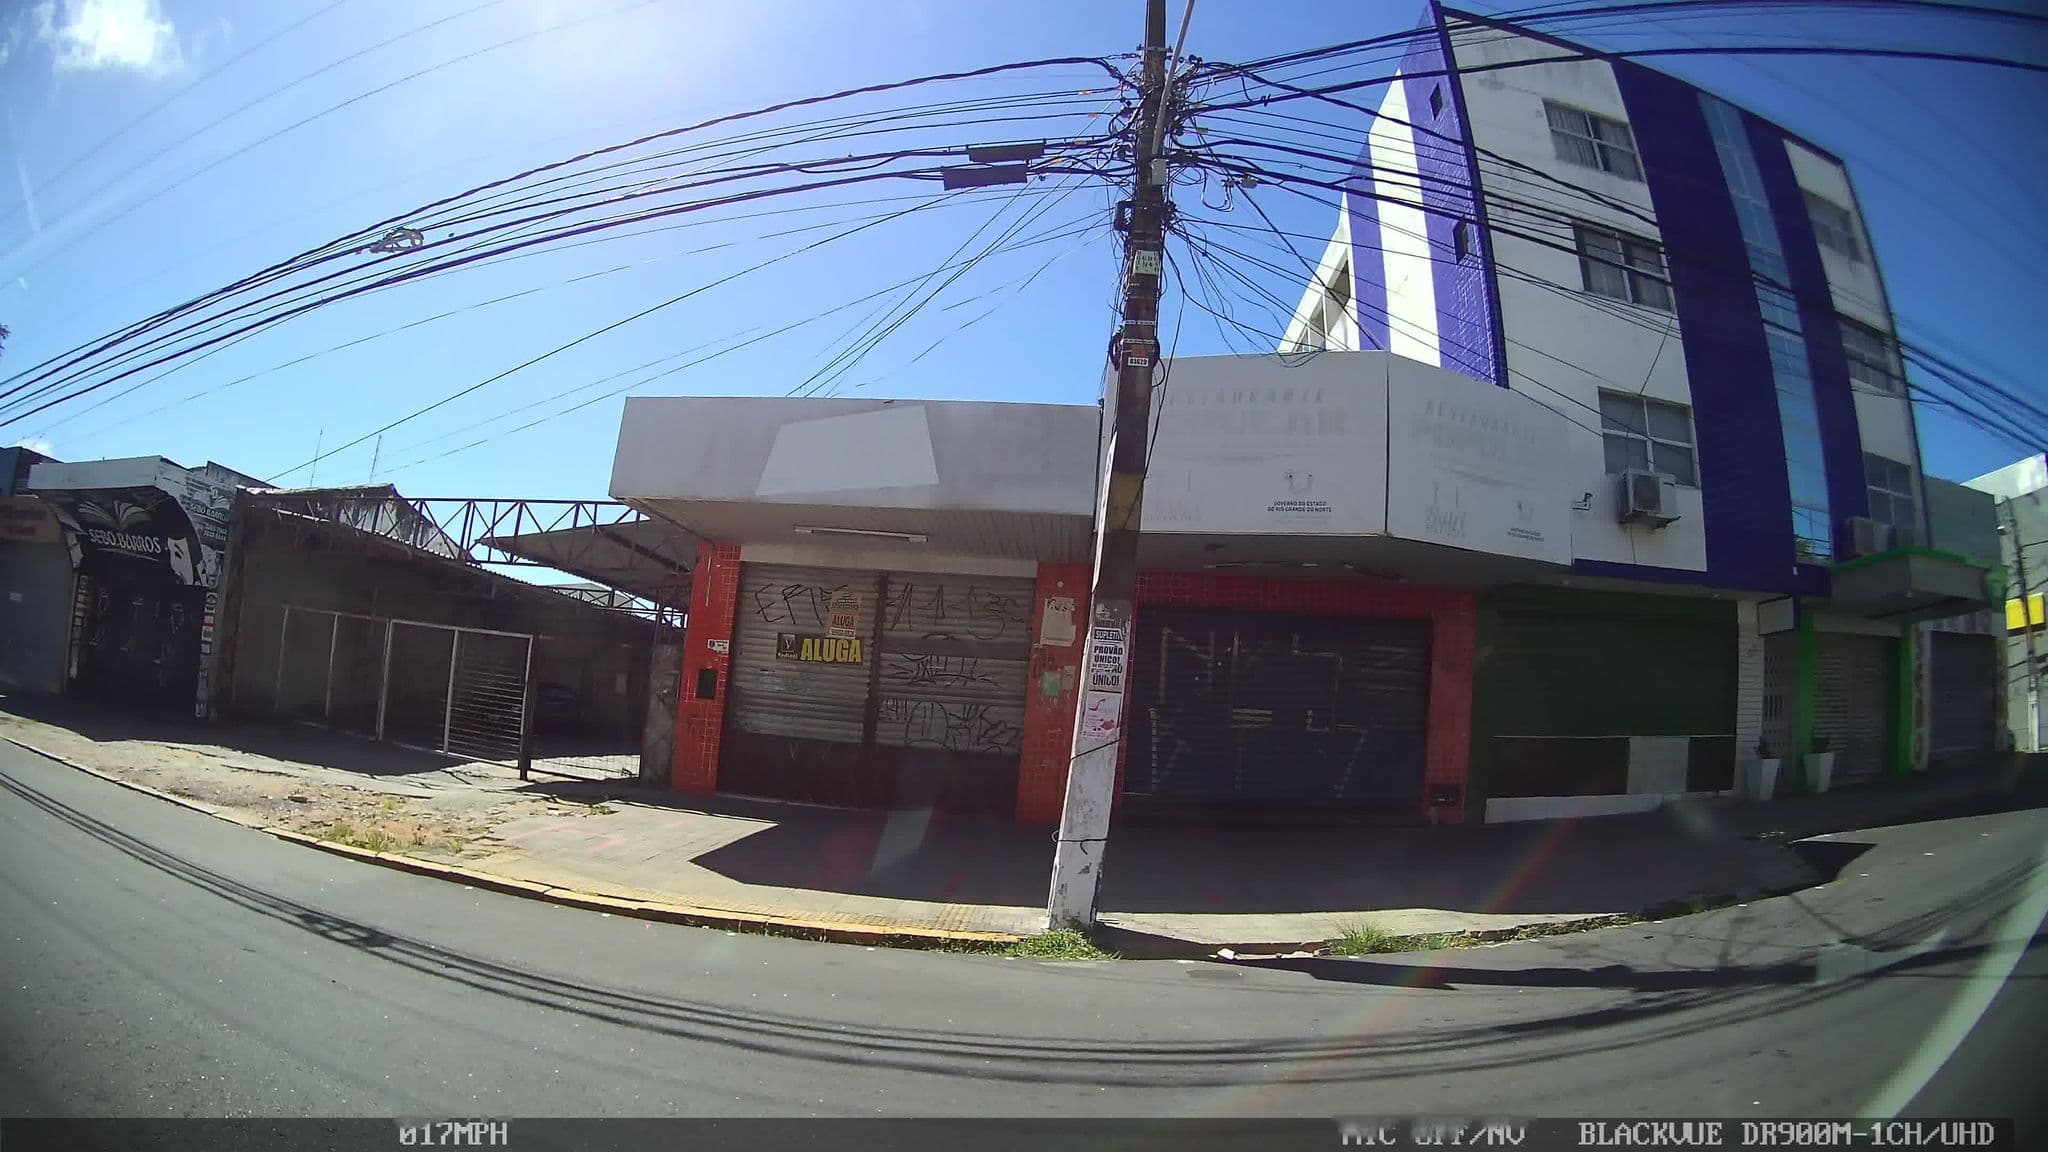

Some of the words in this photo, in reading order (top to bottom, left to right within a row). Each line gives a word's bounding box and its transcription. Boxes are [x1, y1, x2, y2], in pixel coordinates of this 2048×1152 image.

[831, 614, 855, 628] ALUGA
[801, 638, 862, 662] ALUGA
[1094, 645, 1123, 655] PROVÃO
